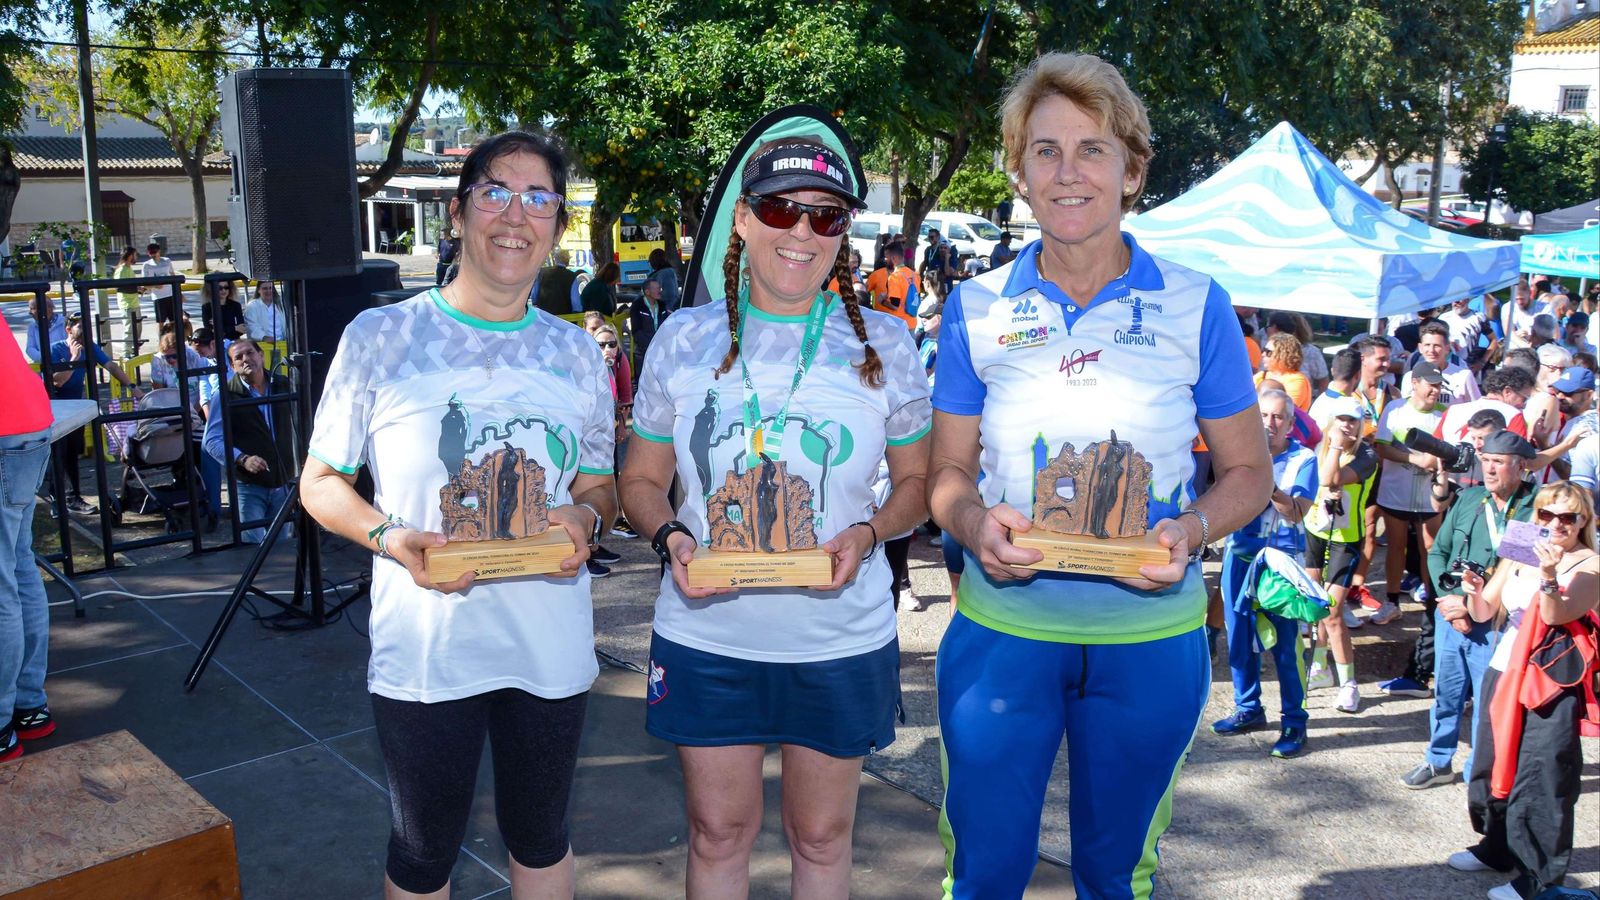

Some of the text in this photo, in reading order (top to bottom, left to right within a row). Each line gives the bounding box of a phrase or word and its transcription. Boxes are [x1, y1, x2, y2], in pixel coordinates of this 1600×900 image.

[773, 154, 844, 184] IRONMAN
[1114, 329, 1156, 347] CHIPIONA
[481, 566, 526, 575] SPORTMADNESS
